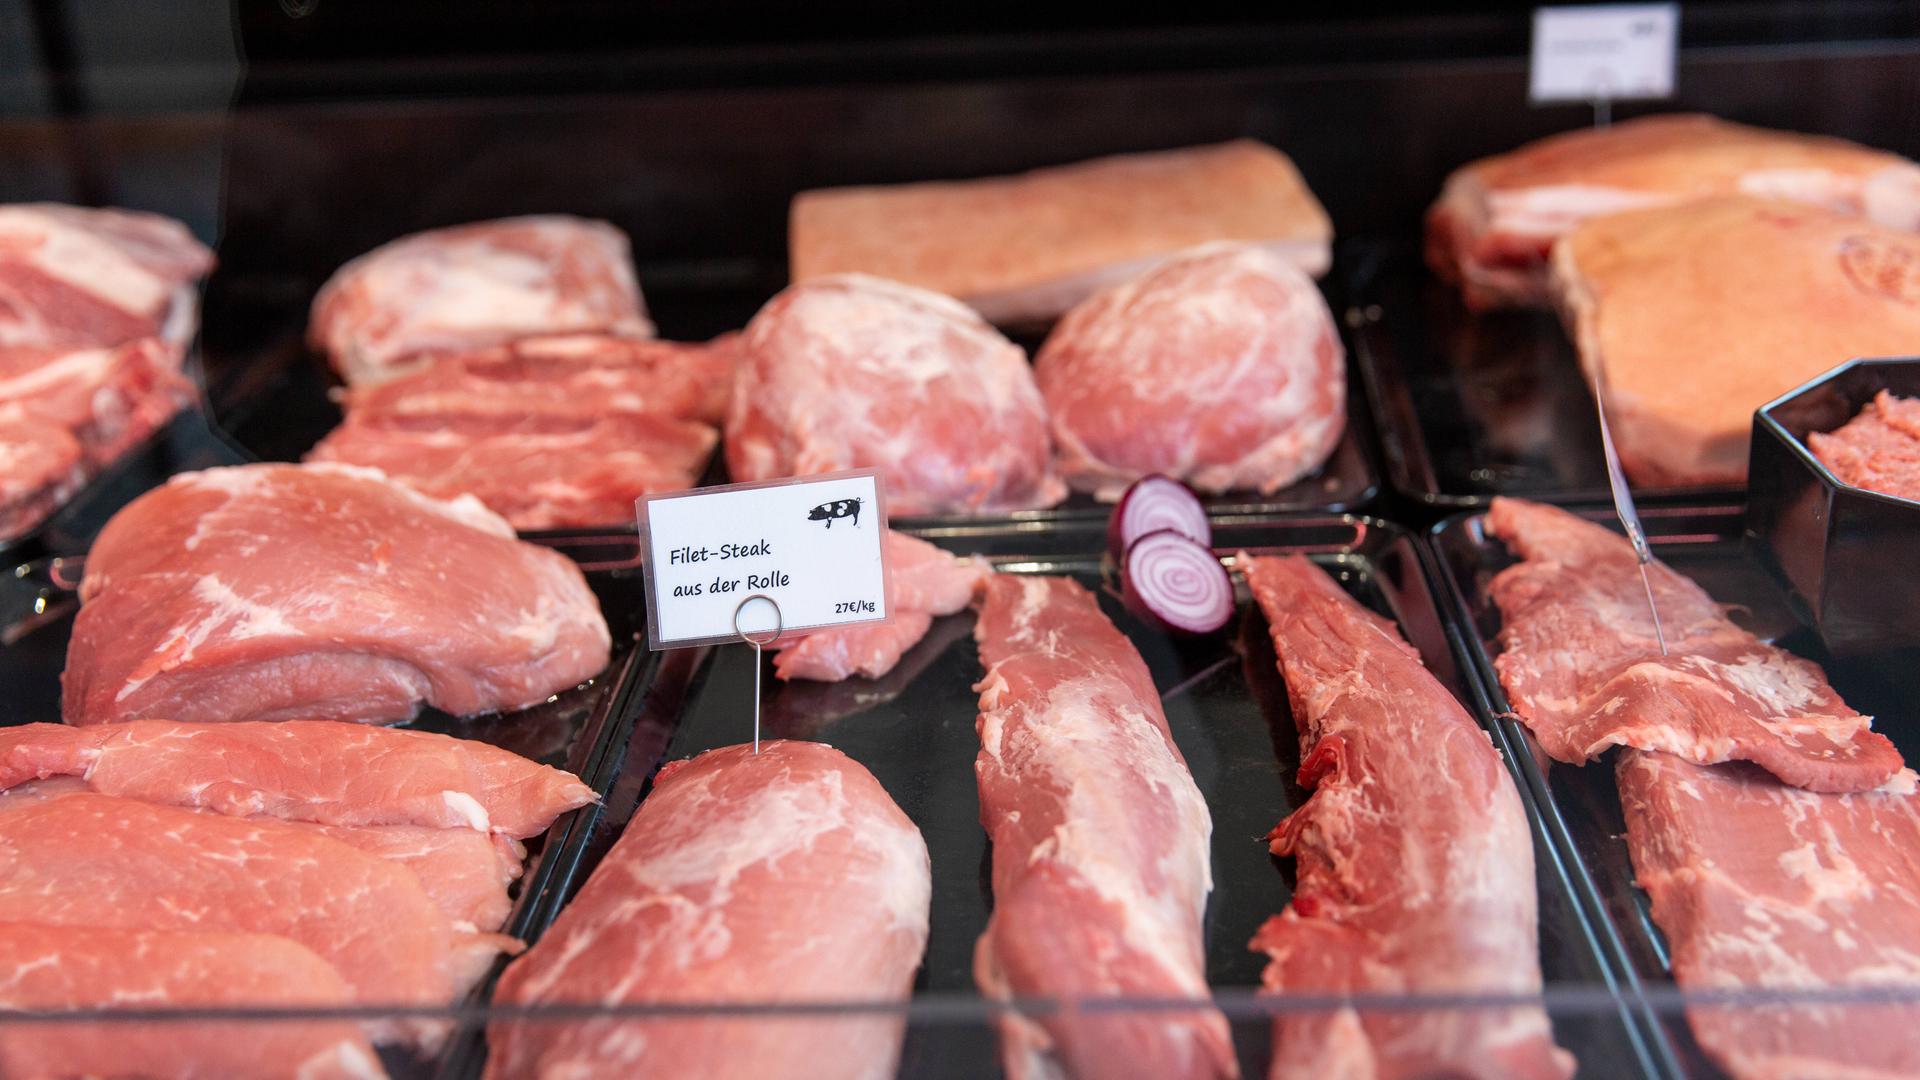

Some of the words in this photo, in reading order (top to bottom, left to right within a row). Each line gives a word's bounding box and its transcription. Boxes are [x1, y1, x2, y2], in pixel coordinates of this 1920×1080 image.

[670, 539, 771, 565] Filet-Steak
[673, 582, 702, 597] aus
[709, 577, 741, 594] der
[747, 570, 790, 591] Rolle
[835, 600, 876, 614] 27€/kg
